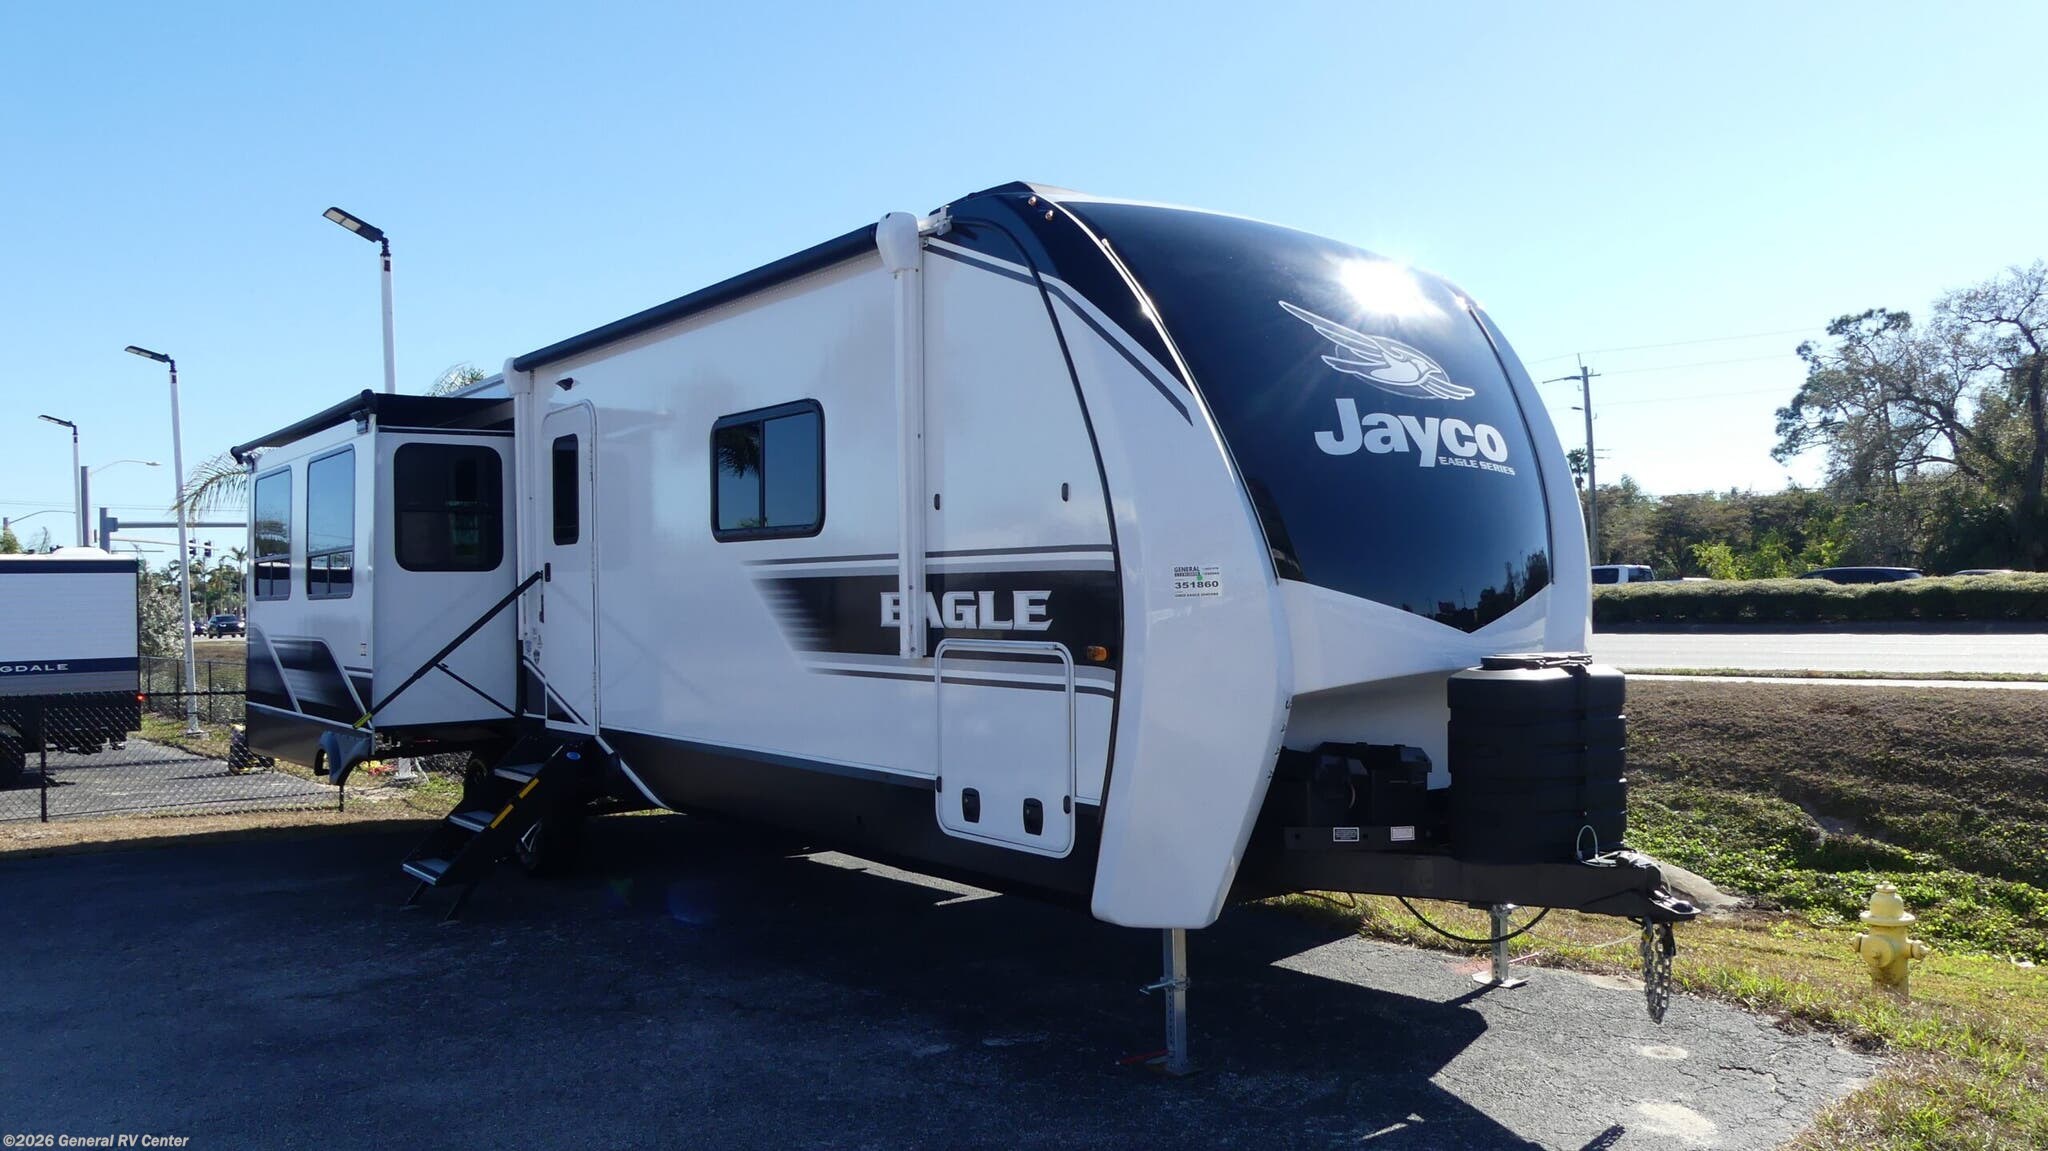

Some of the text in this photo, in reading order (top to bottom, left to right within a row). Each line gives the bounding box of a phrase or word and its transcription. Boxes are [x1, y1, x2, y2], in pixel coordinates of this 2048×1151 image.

[1314, 398, 1508, 467] Jayco
[1438, 456, 1515, 476] EAGLE SERIES
[1174, 581, 1219, 589] 351860
